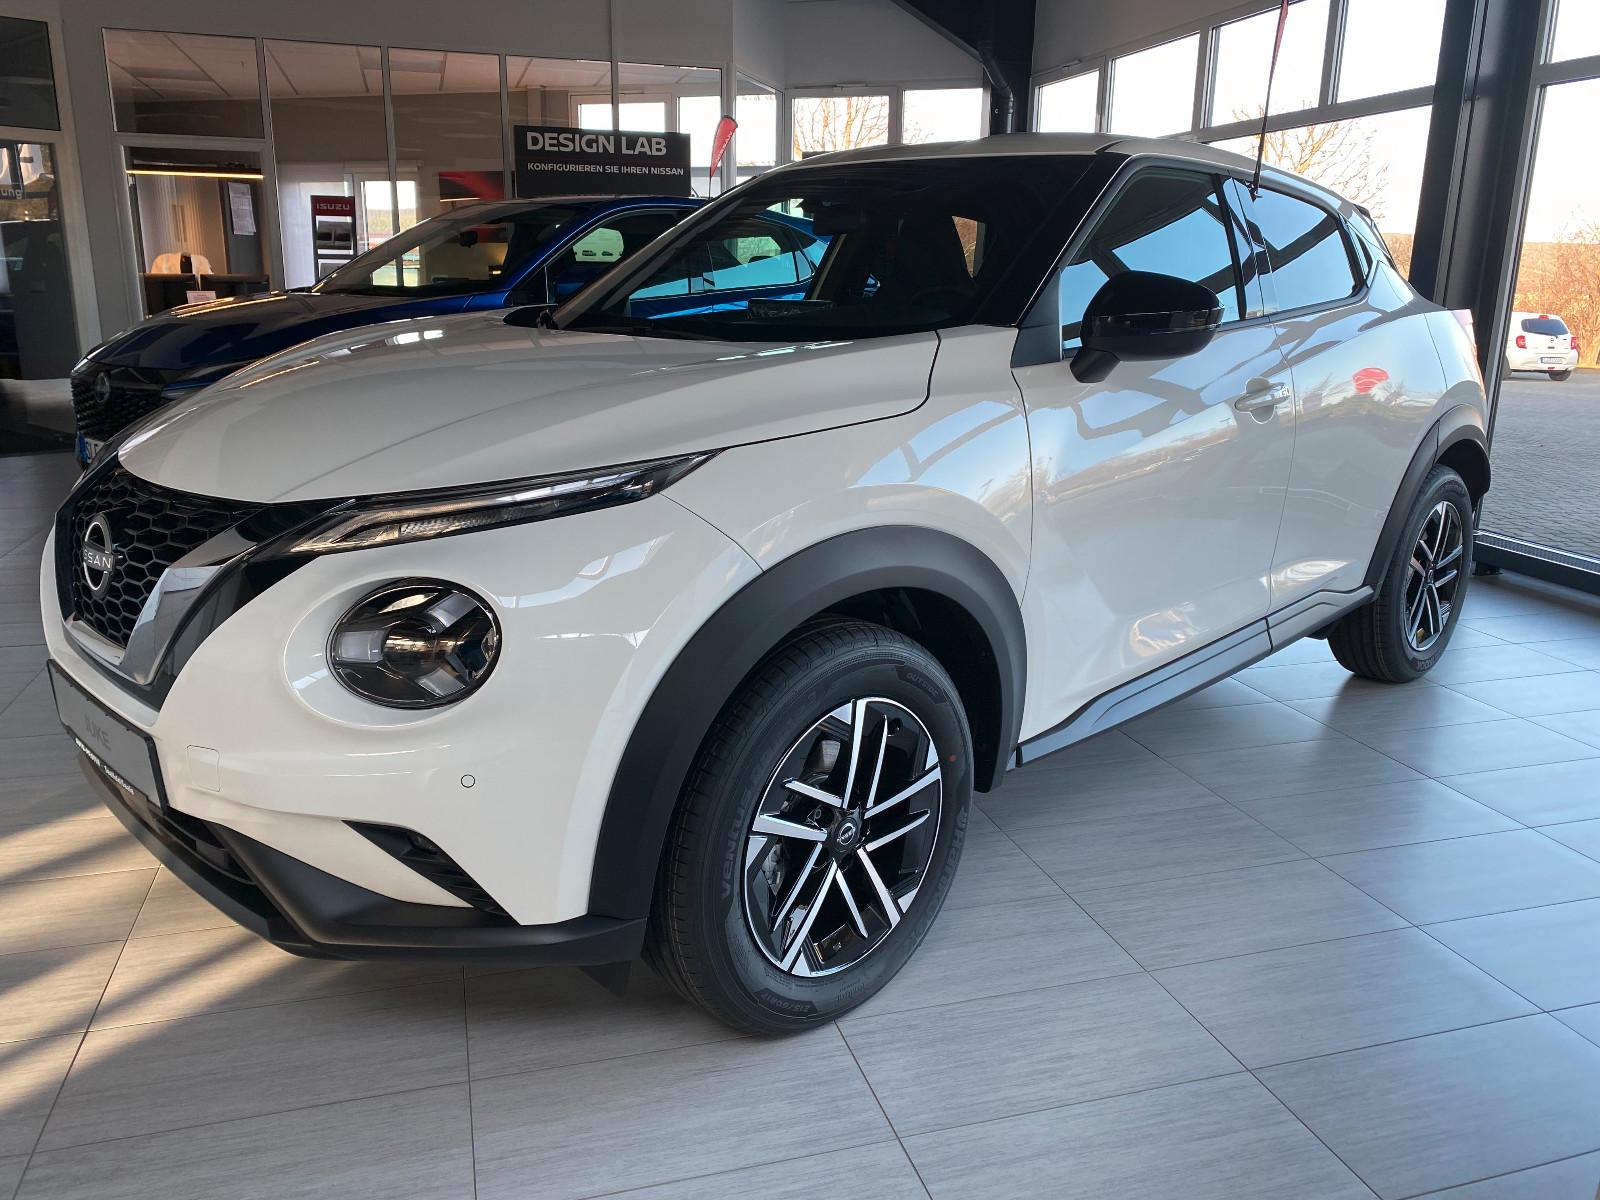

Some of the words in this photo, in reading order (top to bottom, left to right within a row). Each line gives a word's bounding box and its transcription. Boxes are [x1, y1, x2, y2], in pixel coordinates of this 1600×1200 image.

[526, 131, 615, 154] DESIGN
[621, 135, 667, 156] LAB
[527, 162, 602, 173] KONFIGURIEREN
[604, 165, 620, 173] SIE
[621, 166, 649, 174] IHREN
[650, 167, 684, 176] NISSAN
[316, 202, 350, 211] ISUZU
[83, 549, 112, 569] SSAN
